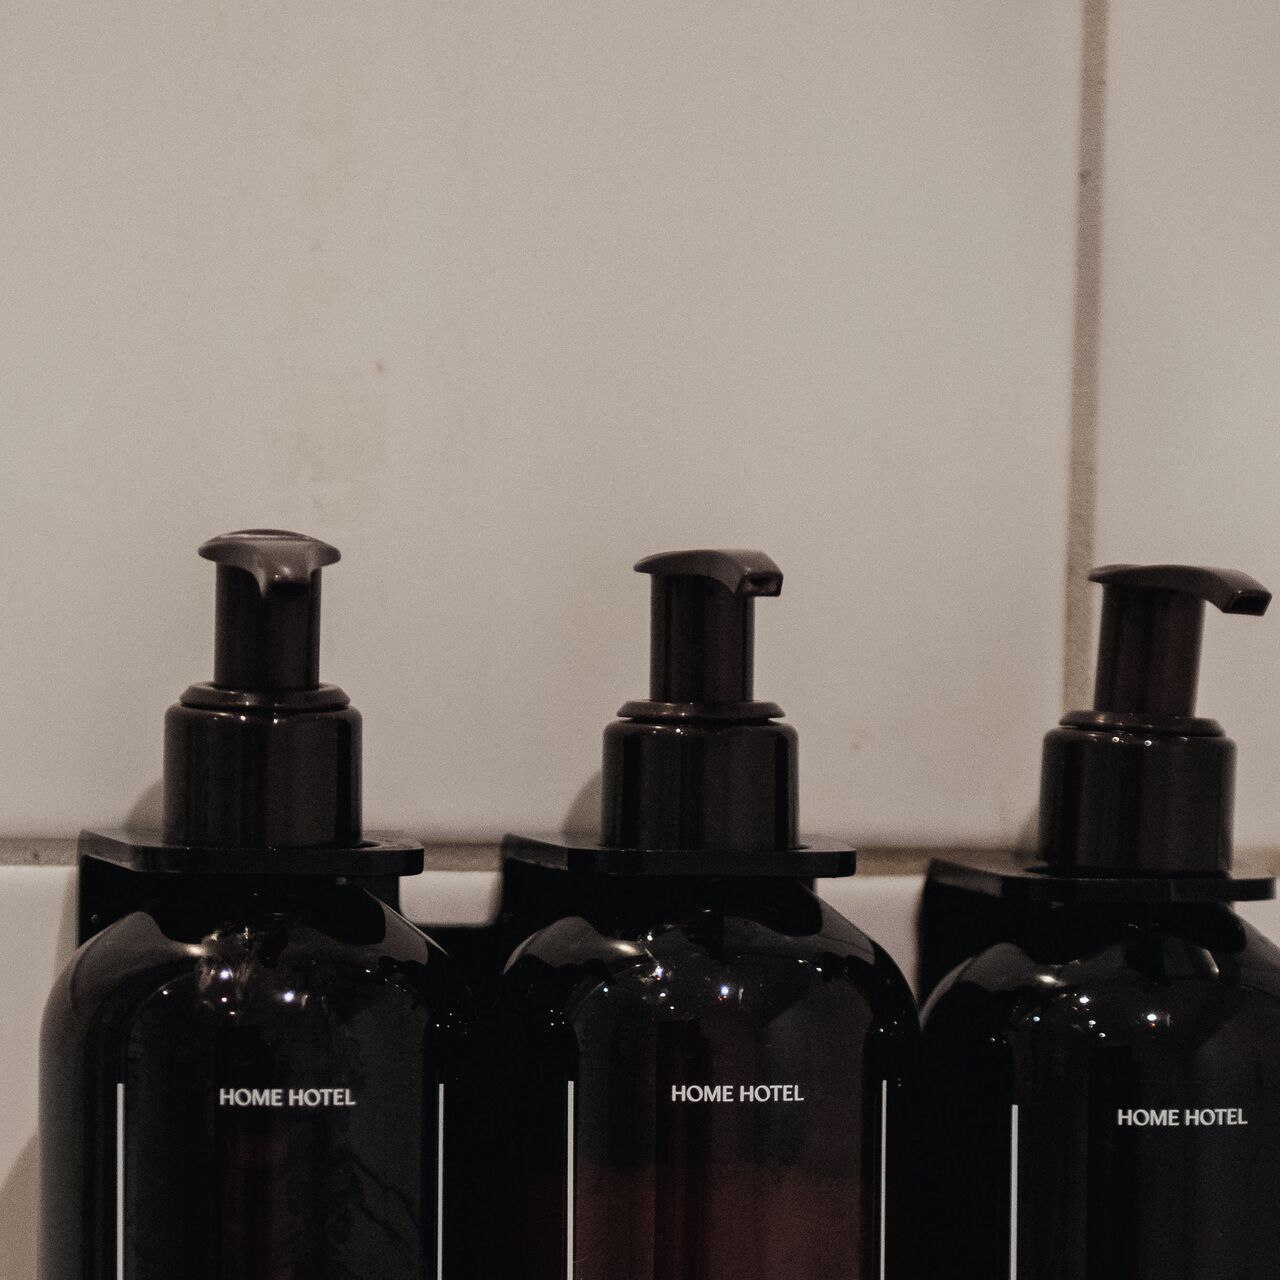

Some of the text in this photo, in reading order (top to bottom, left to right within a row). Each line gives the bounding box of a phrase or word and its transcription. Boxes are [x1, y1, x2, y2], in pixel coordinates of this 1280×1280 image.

[219, 1088, 356, 1107] HOME HOTEL
[671, 1084, 805, 1103] HOME HOTEL
[1117, 1107, 1249, 1127] HOME HOTEL
